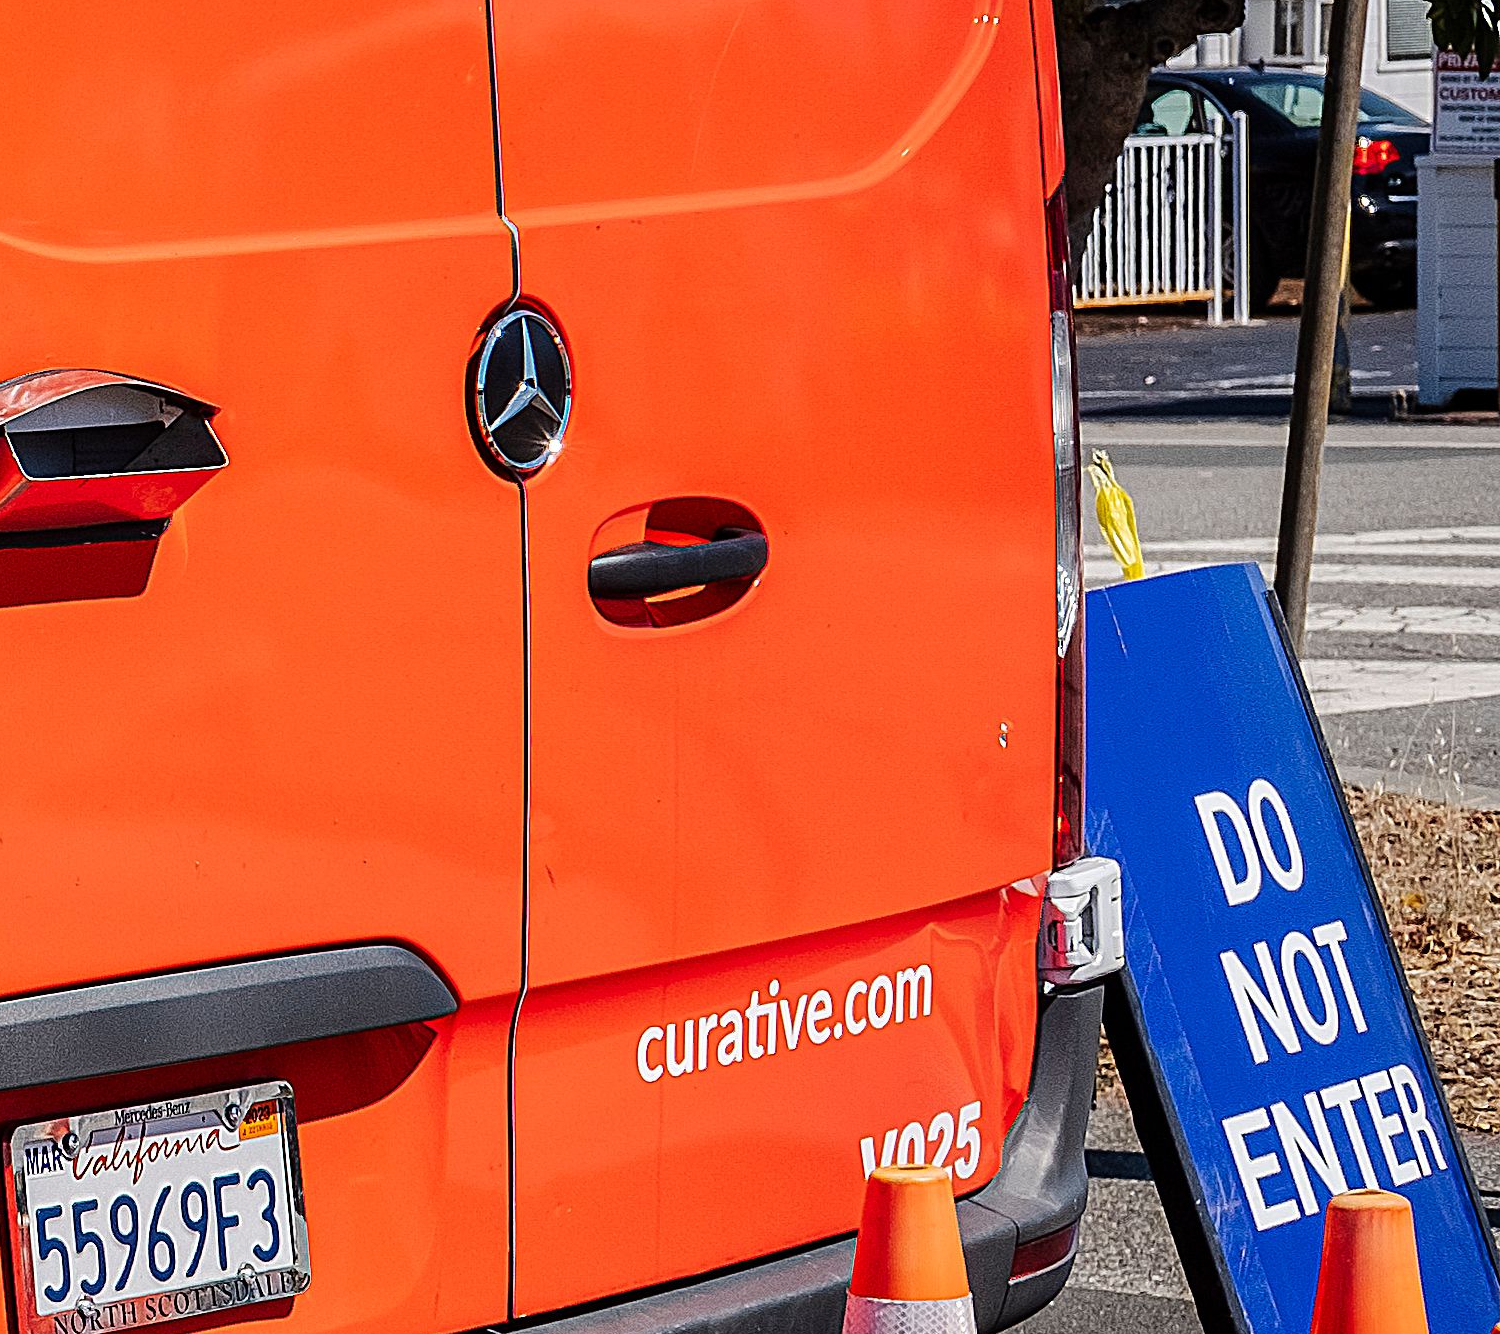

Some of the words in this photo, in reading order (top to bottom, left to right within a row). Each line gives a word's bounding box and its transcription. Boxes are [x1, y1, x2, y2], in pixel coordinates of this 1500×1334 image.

[1194, 778, 1304, 907] DO
[637, 964, 932, 1083] curative.com
[1219, 920, 1368, 1065] NOT
[25, 1144, 65, 1176] MAR
[72, 1122, 240, 1185] California
[114, 1101, 191, 1126] Mercedes-Benz
[1221, 1063, 1449, 1233] ENTER
[36, 1168, 279, 1303] 55969F3
